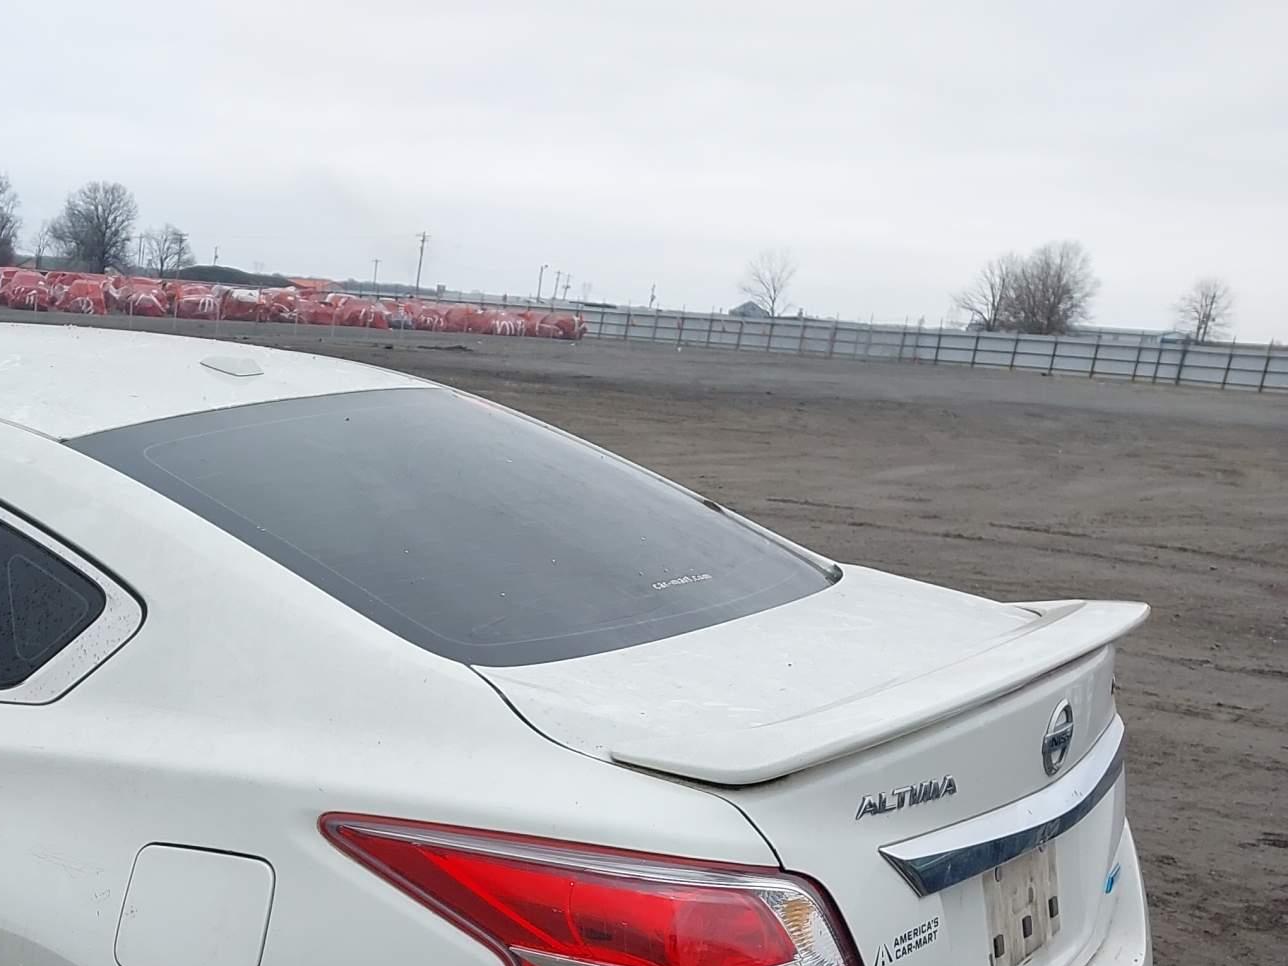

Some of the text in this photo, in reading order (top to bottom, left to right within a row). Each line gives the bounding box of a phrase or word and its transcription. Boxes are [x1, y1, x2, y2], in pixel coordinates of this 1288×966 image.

[855, 775, 957, 820] ALTIMA
[893, 916, 939, 948] AMERICA'S
[895, 929, 938, 960] CAR-MART
